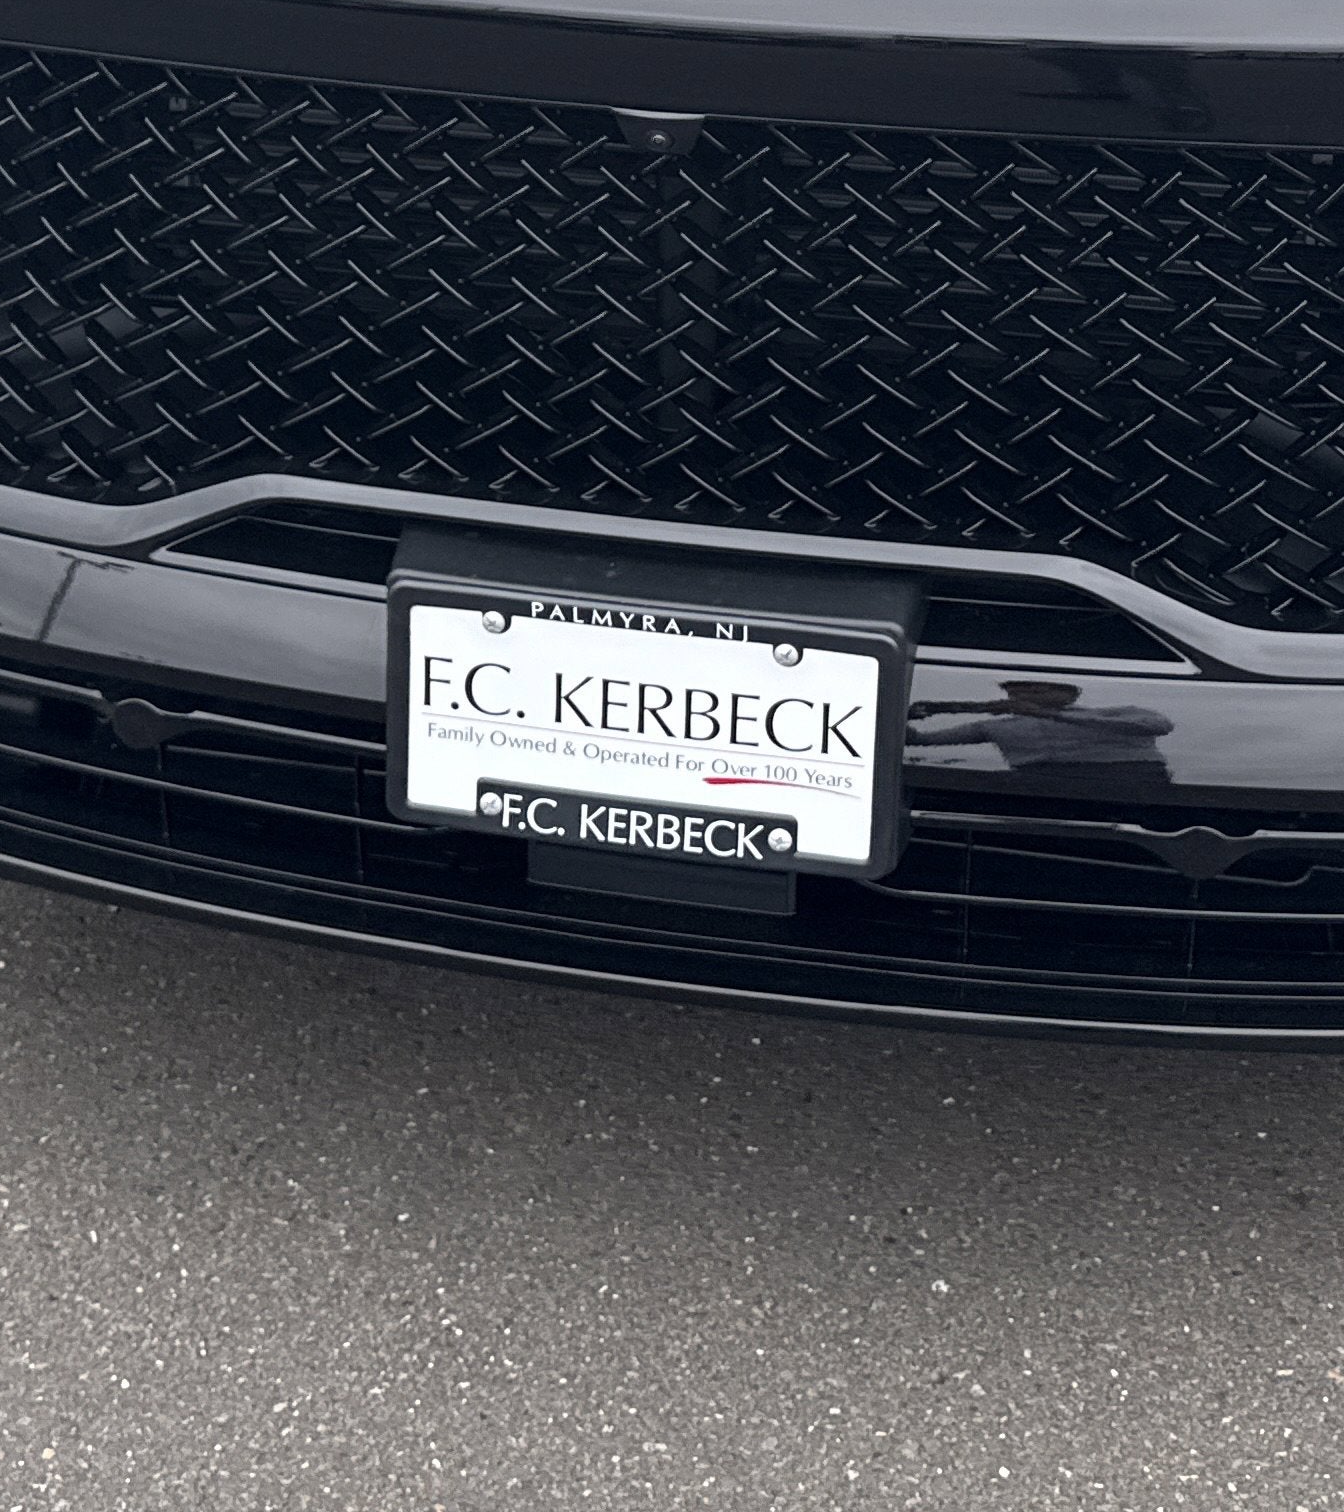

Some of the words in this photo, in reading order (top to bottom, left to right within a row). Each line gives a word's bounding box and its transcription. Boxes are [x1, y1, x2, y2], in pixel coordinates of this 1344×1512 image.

[530, 601, 694, 638] PALMYRA,
[715, 622, 749, 643] NJ
[423, 655, 526, 719] F.C.
[554, 672, 864, 758] KERBECK
[427, 722, 485, 747] Family
[489, 730, 557, 754] Owned
[562, 740, 577, 756] &
[583, 742, 670, 768] Operated
[675, 754, 705, 771] For
[711, 758, 757, 776] Over
[765, 764, 798, 782] 100
[805, 767, 854, 789] Years
[502, 792, 566, 838] F.C.
[579, 803, 765, 861] KERBECK
